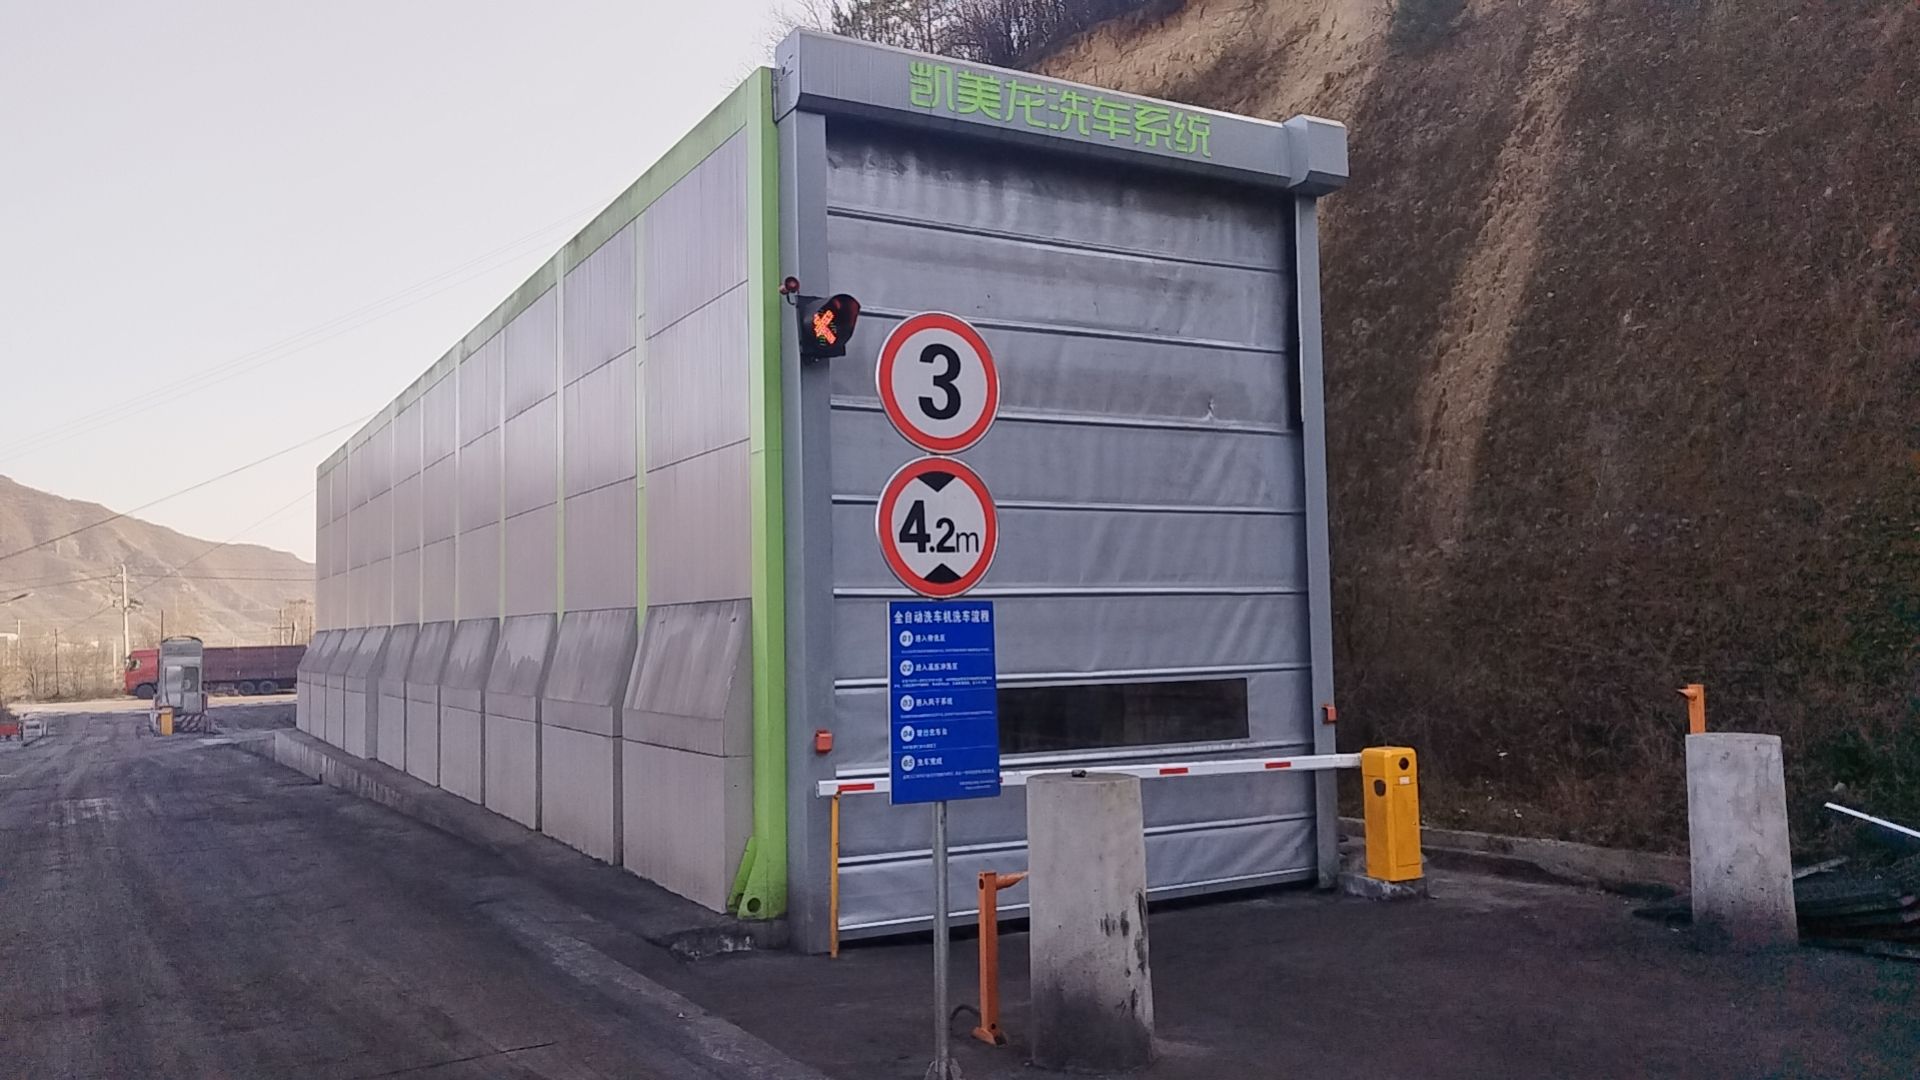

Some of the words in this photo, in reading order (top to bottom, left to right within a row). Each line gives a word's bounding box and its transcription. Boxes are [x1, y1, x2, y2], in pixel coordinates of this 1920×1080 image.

[909, 61, 1212, 158] 凯美龙洗车系统
[918, 343, 961, 420] 3
[899, 500, 979, 553] 4.2m
[894, 609, 990, 624] 全自动洗车机洗车流程
